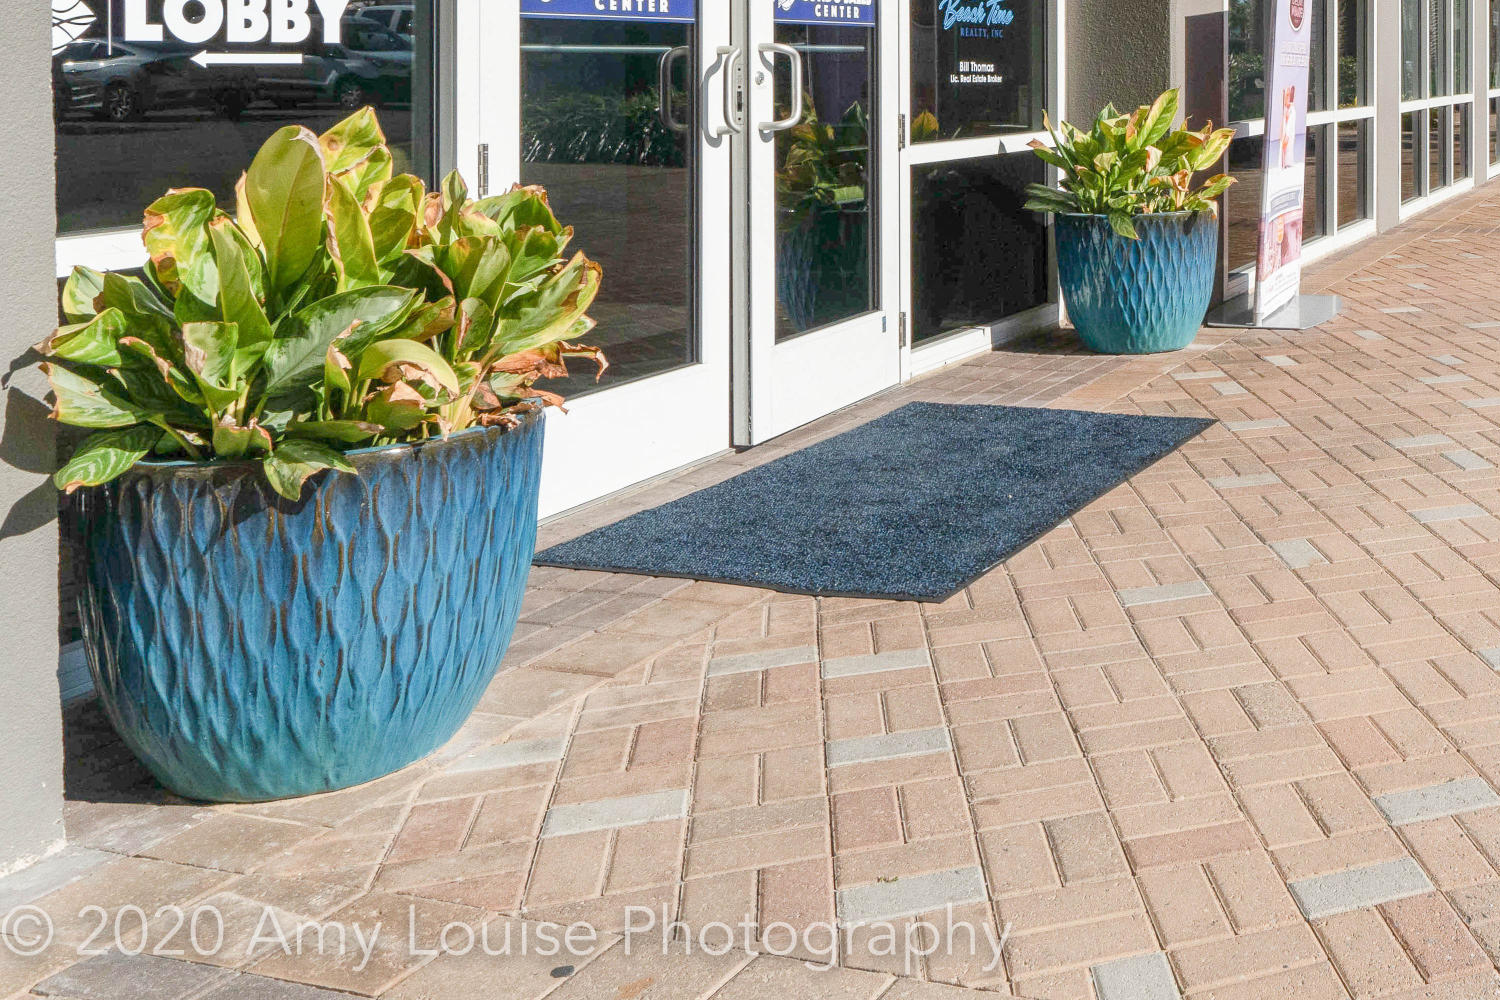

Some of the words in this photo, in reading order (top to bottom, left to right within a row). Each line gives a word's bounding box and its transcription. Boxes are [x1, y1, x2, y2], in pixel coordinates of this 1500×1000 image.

[814, 3, 860, 19] CENTER
[960, 27, 989, 39] REALTY,
[959, 61, 969, 72] Bill
[970, 62, 994, 72] Thomas
[960, 74, 971, 83] Real
